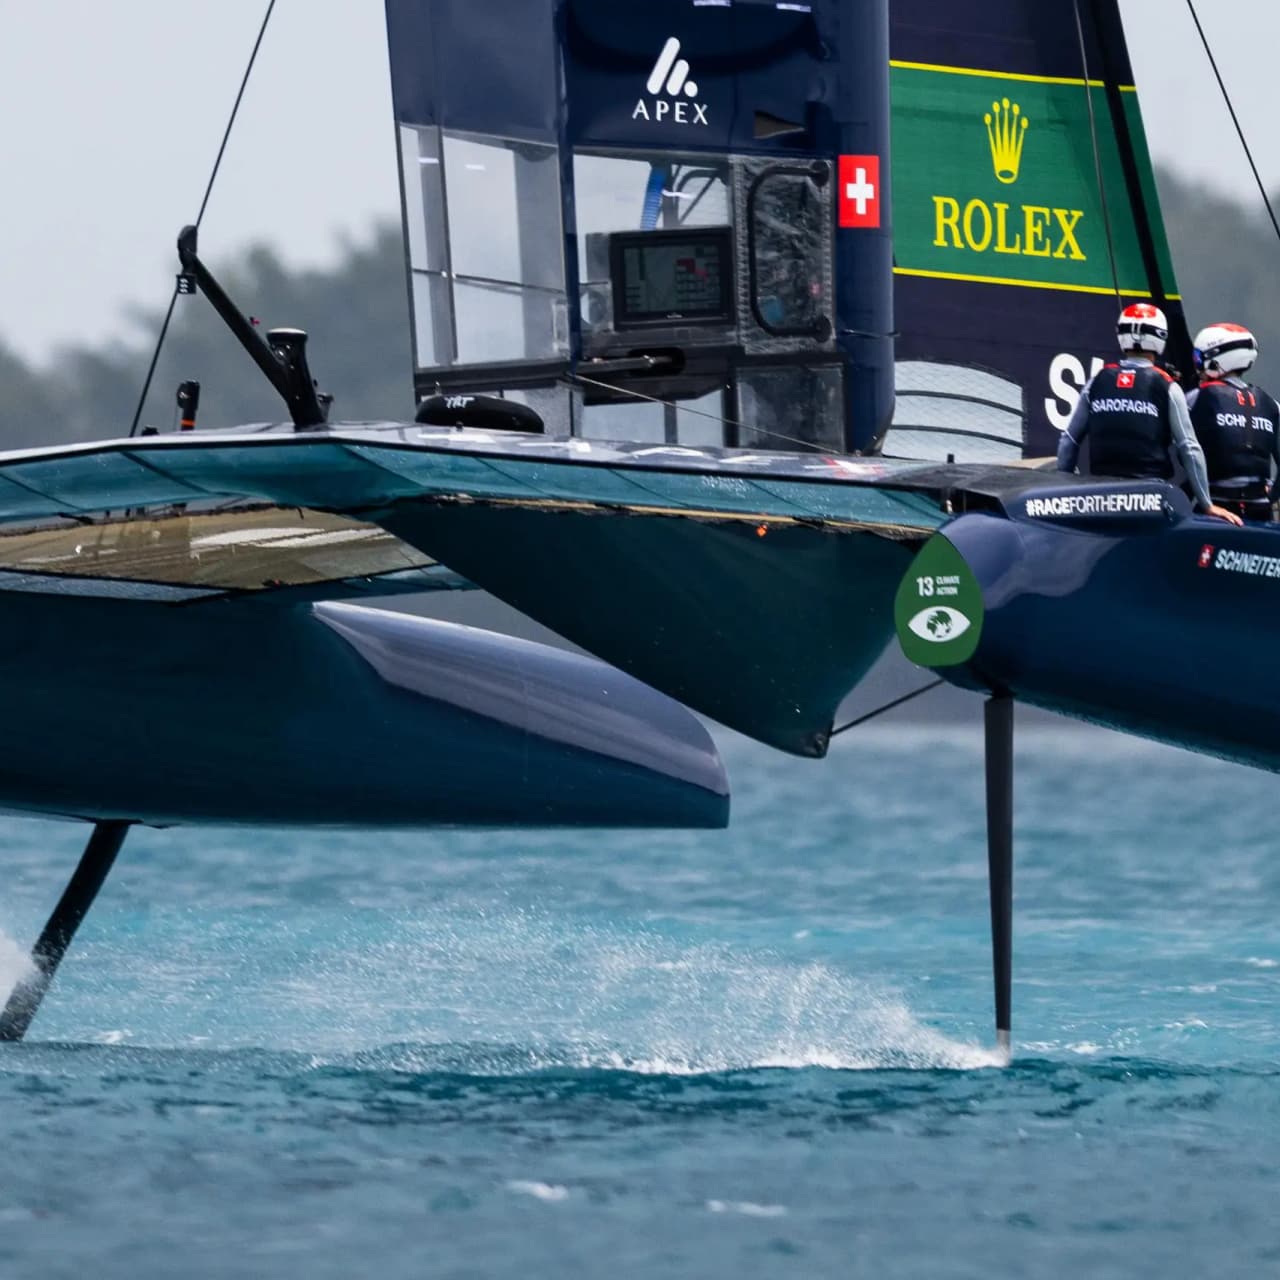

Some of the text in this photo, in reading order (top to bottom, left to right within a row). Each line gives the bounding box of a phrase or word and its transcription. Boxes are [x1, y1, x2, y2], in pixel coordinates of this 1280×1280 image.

[632, 99, 709, 126] APEX
[932, 195, 1087, 261] ROLEX
[1025, 493, 1162, 517] #RACEFORTHEFUTURE
[916, 575, 935, 597] 13
